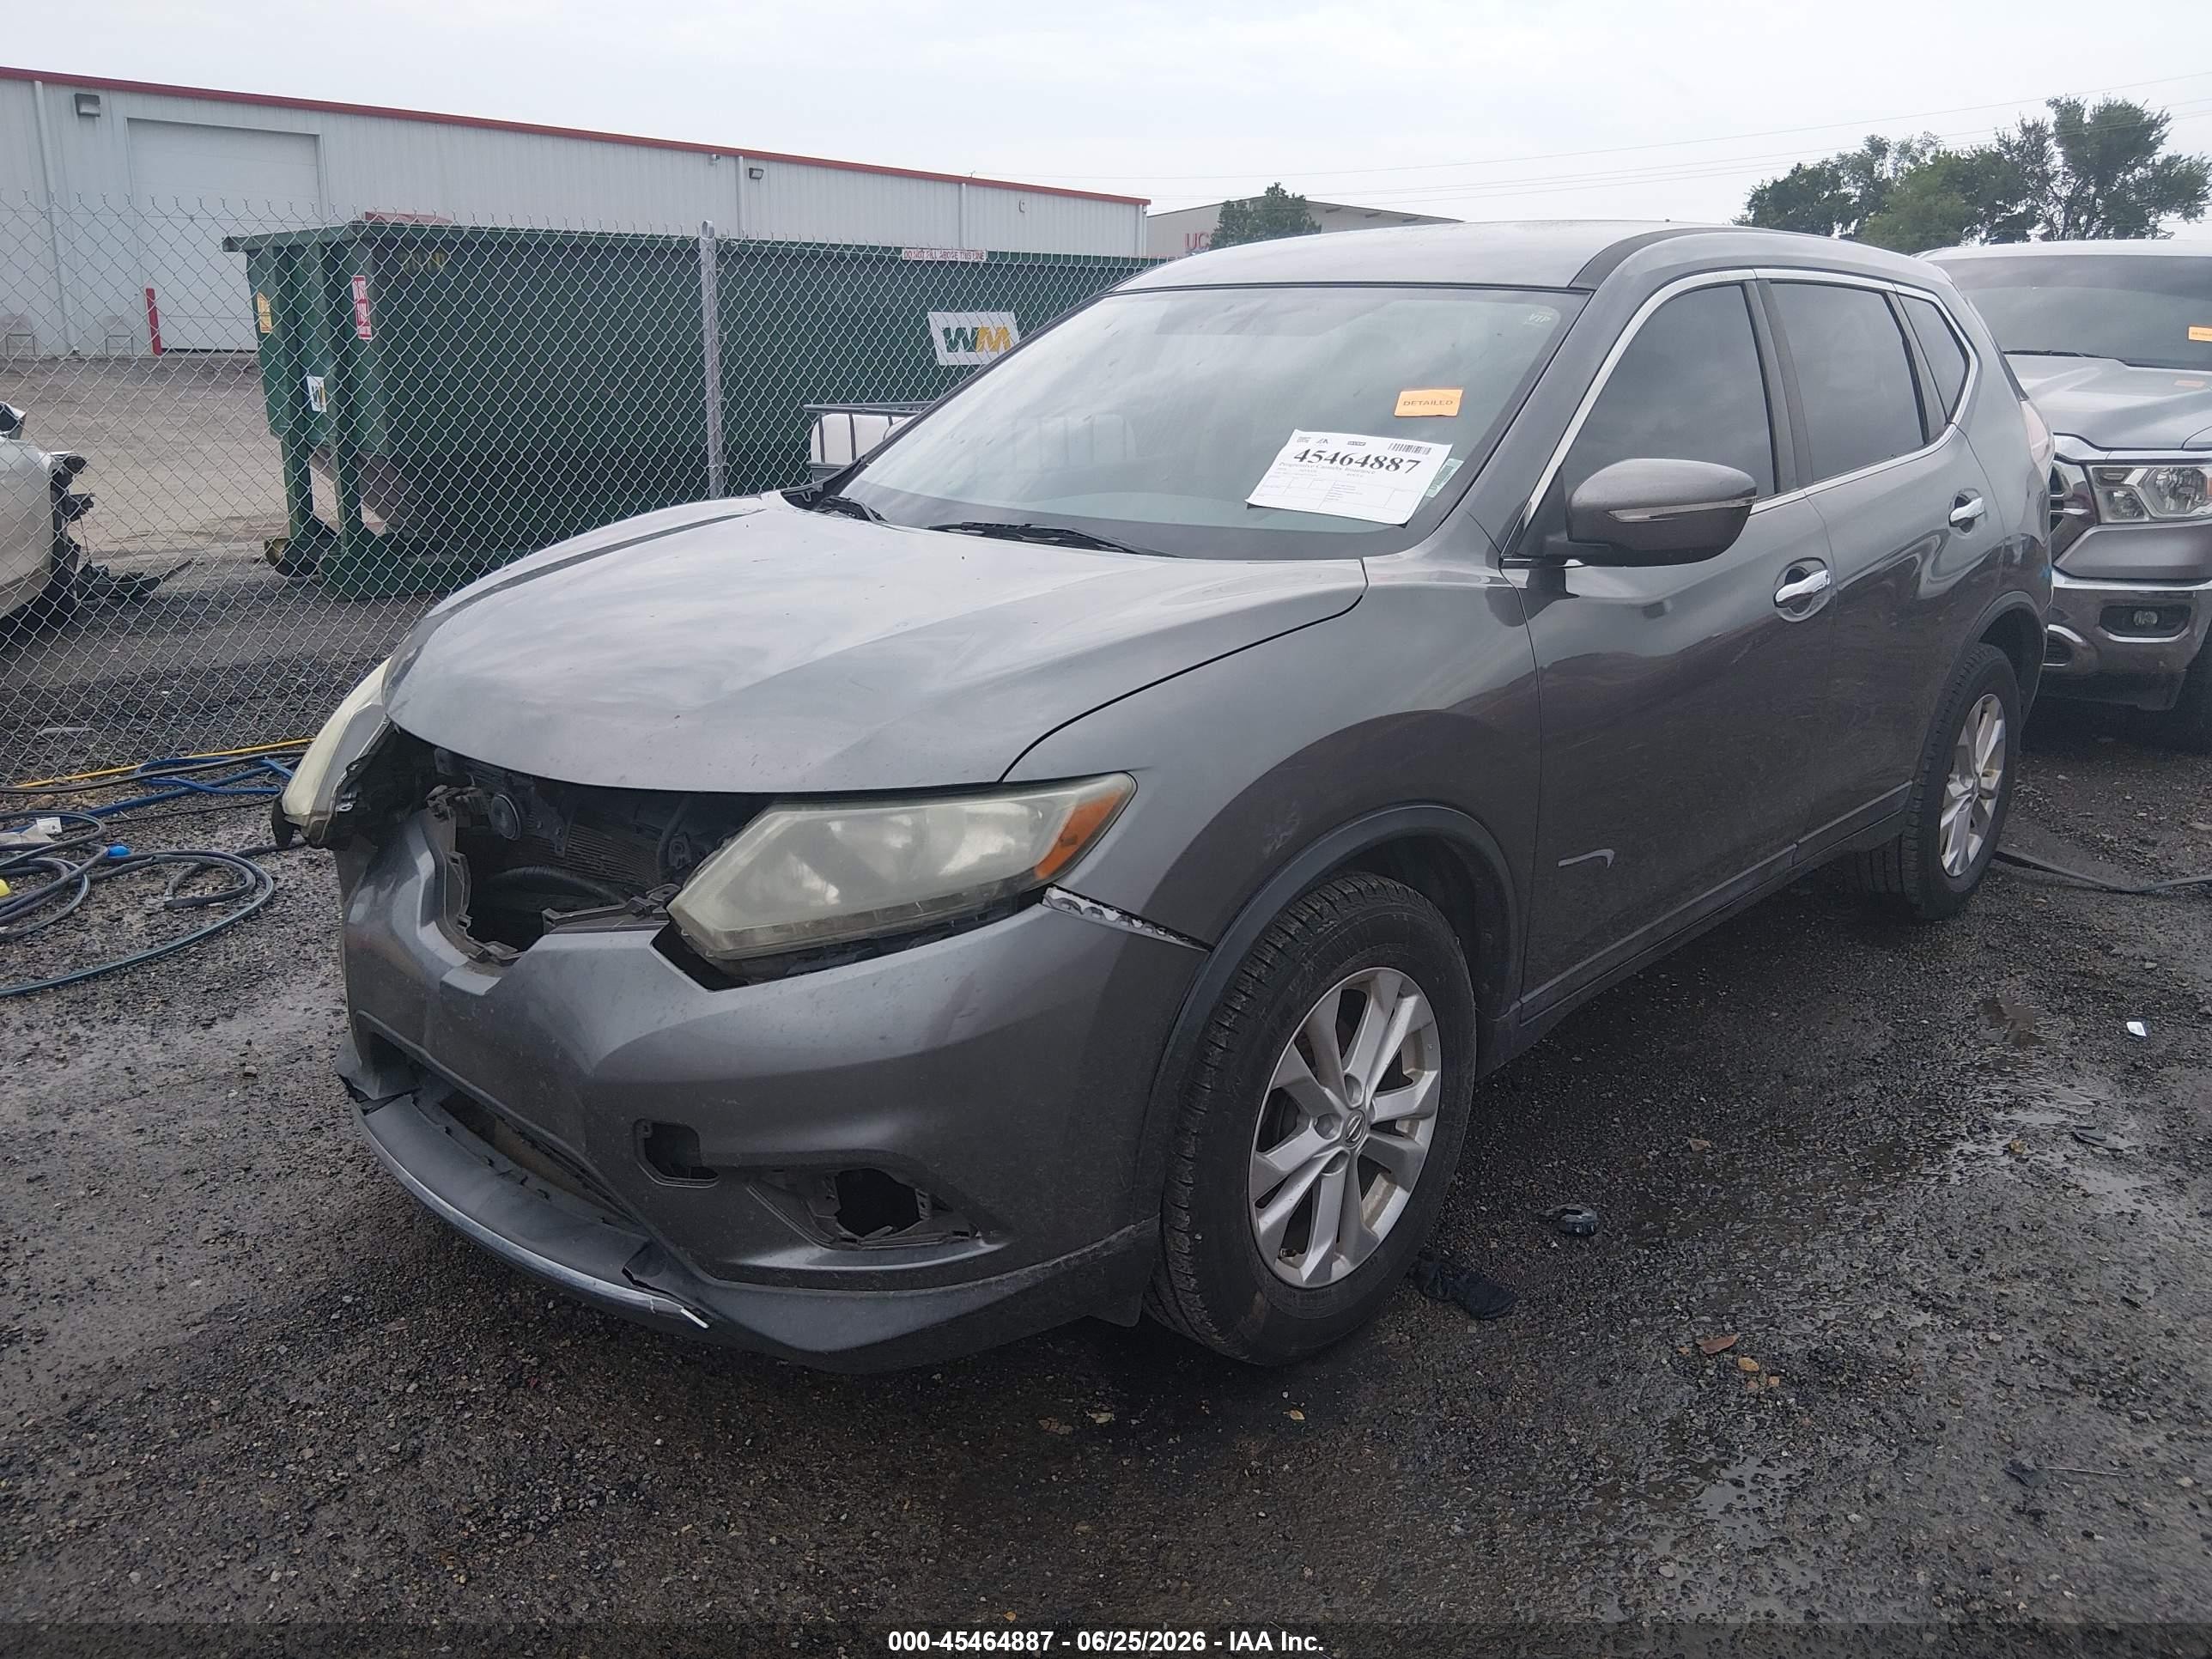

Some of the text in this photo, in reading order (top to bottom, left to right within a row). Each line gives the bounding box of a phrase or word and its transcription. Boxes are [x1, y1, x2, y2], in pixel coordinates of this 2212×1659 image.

[903, 250, 913, 258] DO
[913, 250, 925, 259] NOT
[943, 326, 1012, 352] WM
[1293, 448, 1421, 474] 45464887
